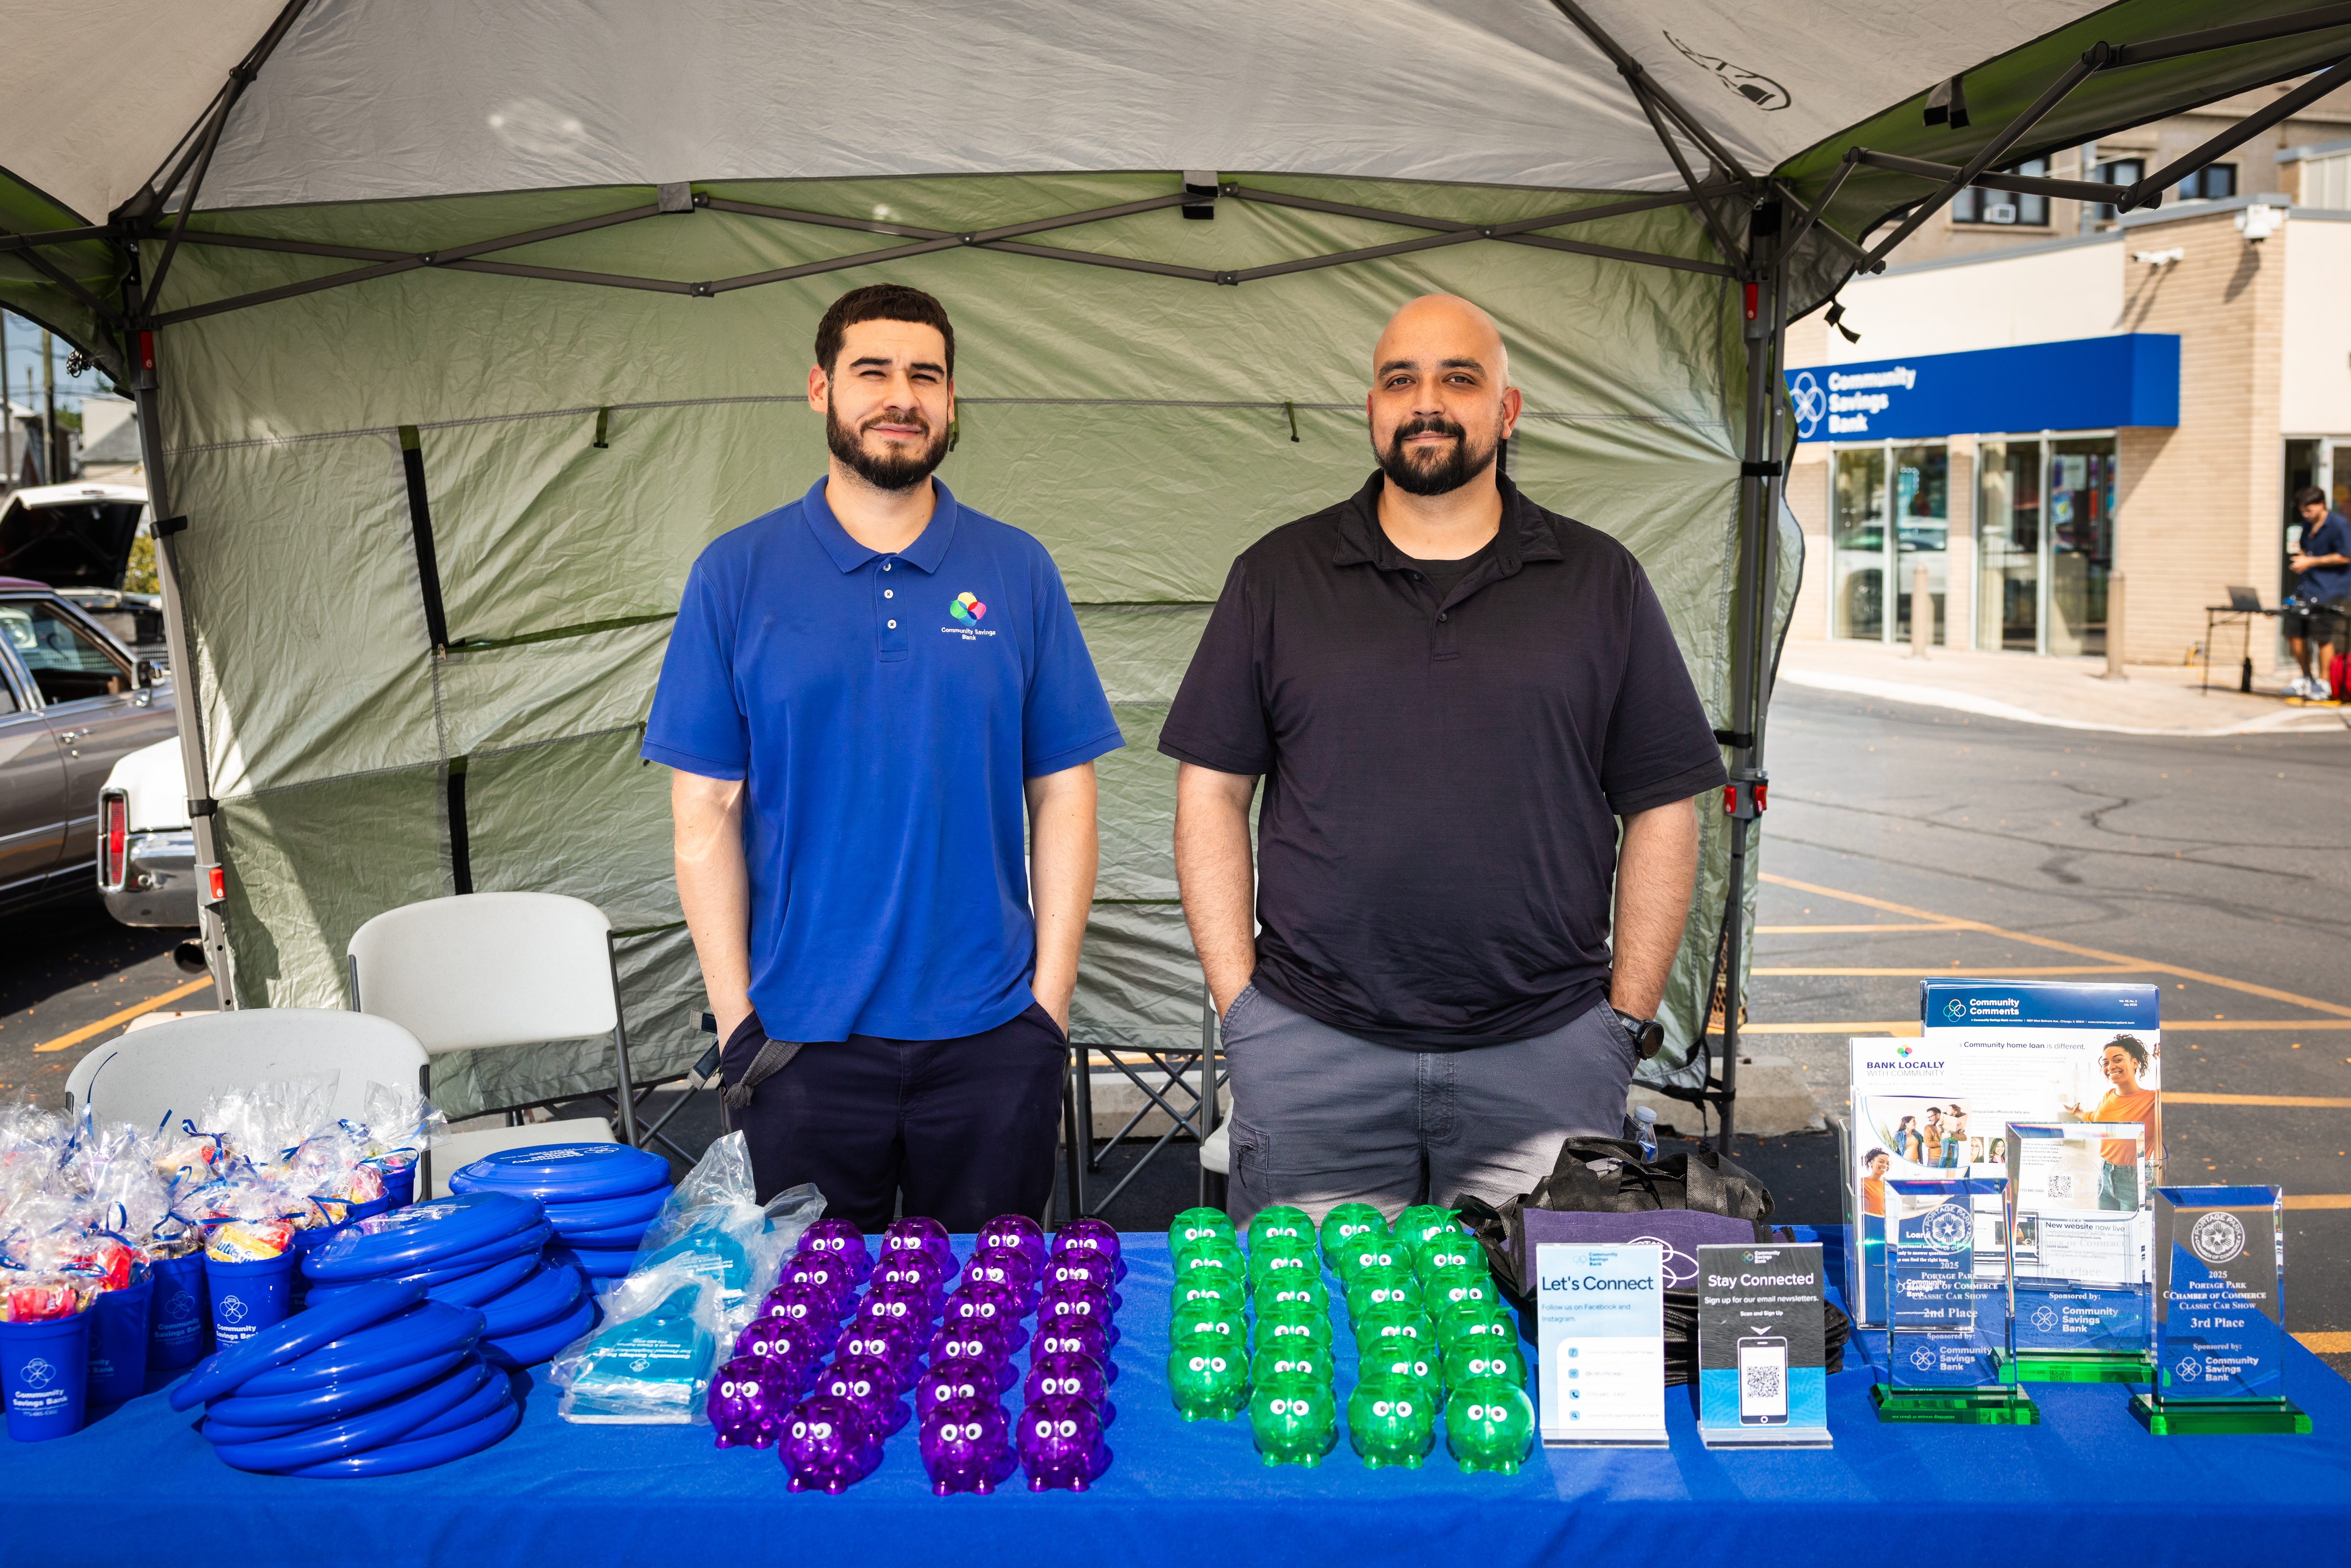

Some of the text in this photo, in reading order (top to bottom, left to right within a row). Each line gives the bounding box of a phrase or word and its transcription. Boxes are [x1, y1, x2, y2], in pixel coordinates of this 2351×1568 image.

[1828, 367, 1916, 391] Community
[1828, 392, 1889, 414] Savings
[1828, 413, 1868, 434] Bank
[1970, 998, 2020, 1008] Community
[512, 1154, 584, 1164] Community
[1925, 1206, 1971, 1227] PORTAGE PARK
[2194, 1214, 2242, 1235] PORTAGE PARK
[2070, 1267, 2102, 1276] Place
[1542, 1276, 1654, 1291] Let's Connect
[1708, 1273, 1814, 1289] Stay Connected
[1704, 1296, 1720, 1305] Sign
[1924, 1308, 1978, 1318] 2nd Place
[2062, 1307, 2119, 1317] Community
[158, 1318, 199, 1330] Community
[2062, 1315, 2100, 1325] Savings
[2191, 1317, 2245, 1328] 3rd Place
[187, 1324, 201, 1333] Bank
[217, 1324, 257, 1332] Community
[216, 1330, 238, 1340] Savings
[1940, 1346, 1992, 1356] Community
[2193, 1343, 2229, 1351] Sponsored
[1940, 1355, 1975, 1364] Savings
[2205, 1356, 2259, 1366] Community
[2205, 1365, 2241, 1374] Savings
[15, 1389, 65, 1398] Community
[12, 1398, 44, 1408] Savings
[46, 1395, 69, 1405] Bank
